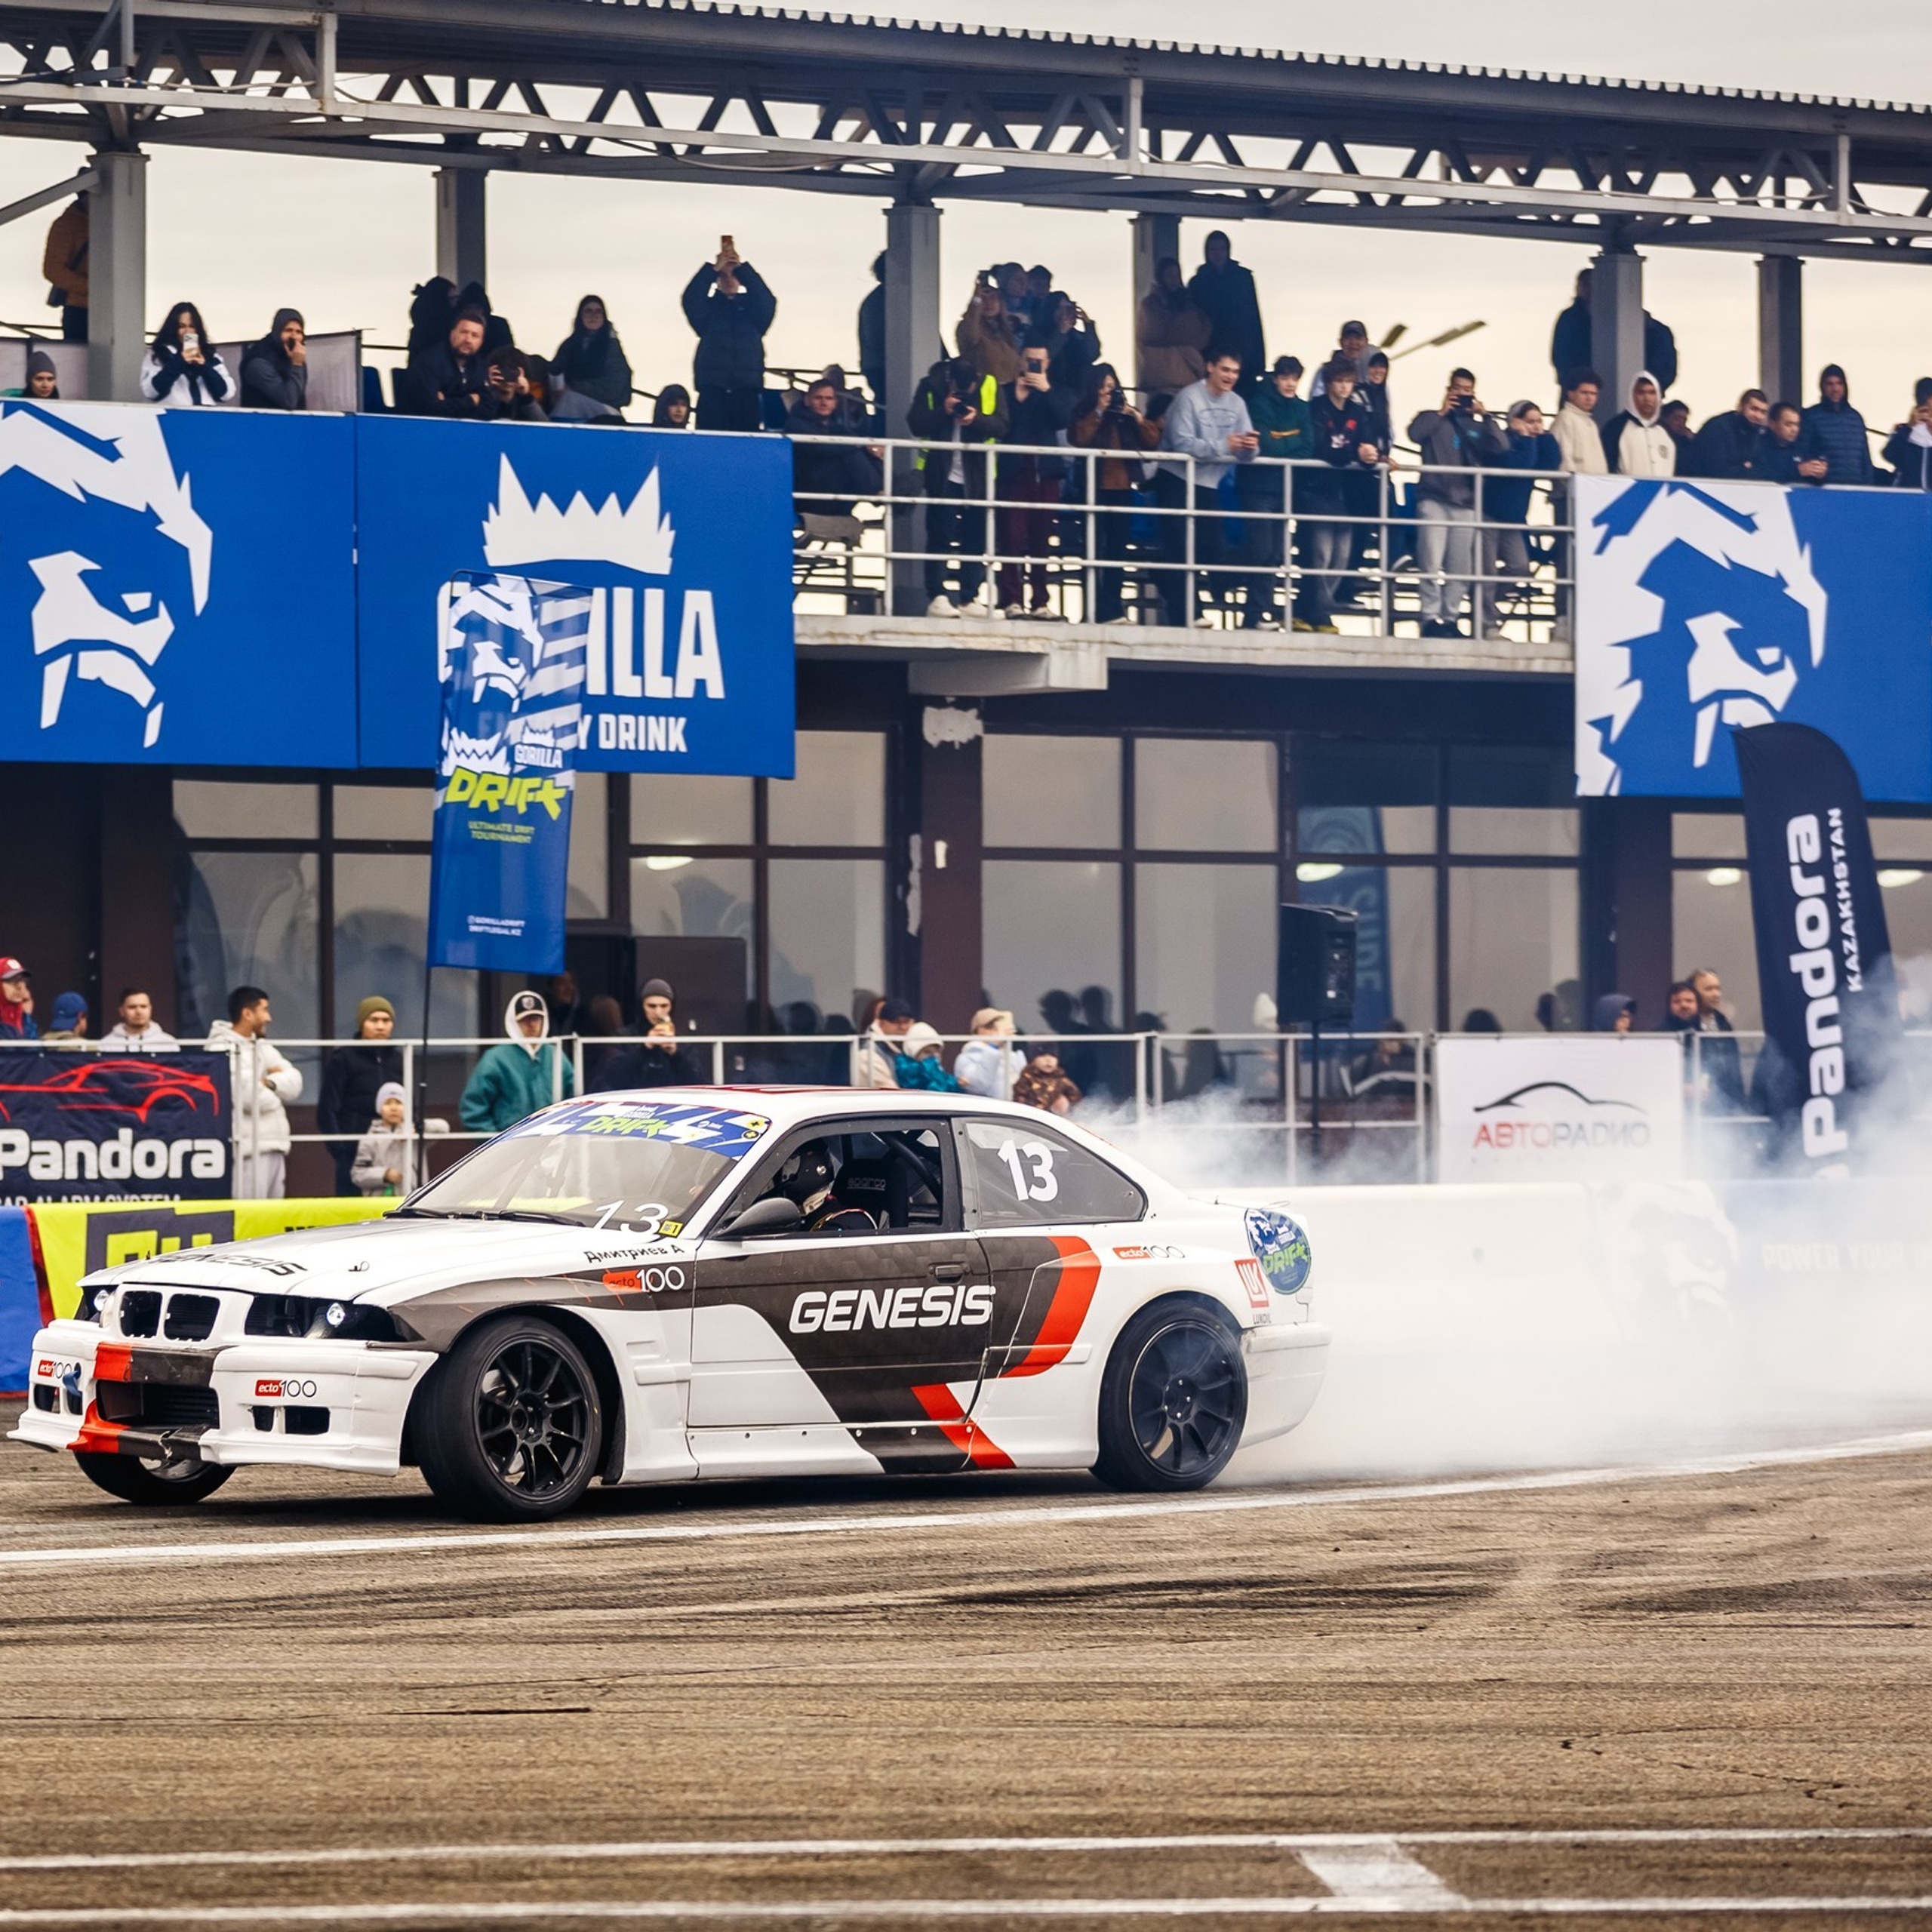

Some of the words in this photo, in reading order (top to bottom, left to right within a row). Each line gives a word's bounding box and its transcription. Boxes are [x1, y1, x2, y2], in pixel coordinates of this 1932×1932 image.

[598, 712, 688, 753] DRINK
[514, 743, 564, 768] GORILLA
[445, 767, 567, 821] DRIFT
[1827, 807, 1863, 993] KAZAKHSTAN
[576, 1116, 673, 1139] DRIFT
[0, 1128, 226, 1180] Pandora
[997, 1140, 1058, 1202] 13
[848, 1177, 887, 1192] sparco
[593, 1199, 669, 1241] 13
[789, 1285, 996, 1334] GENESIS
